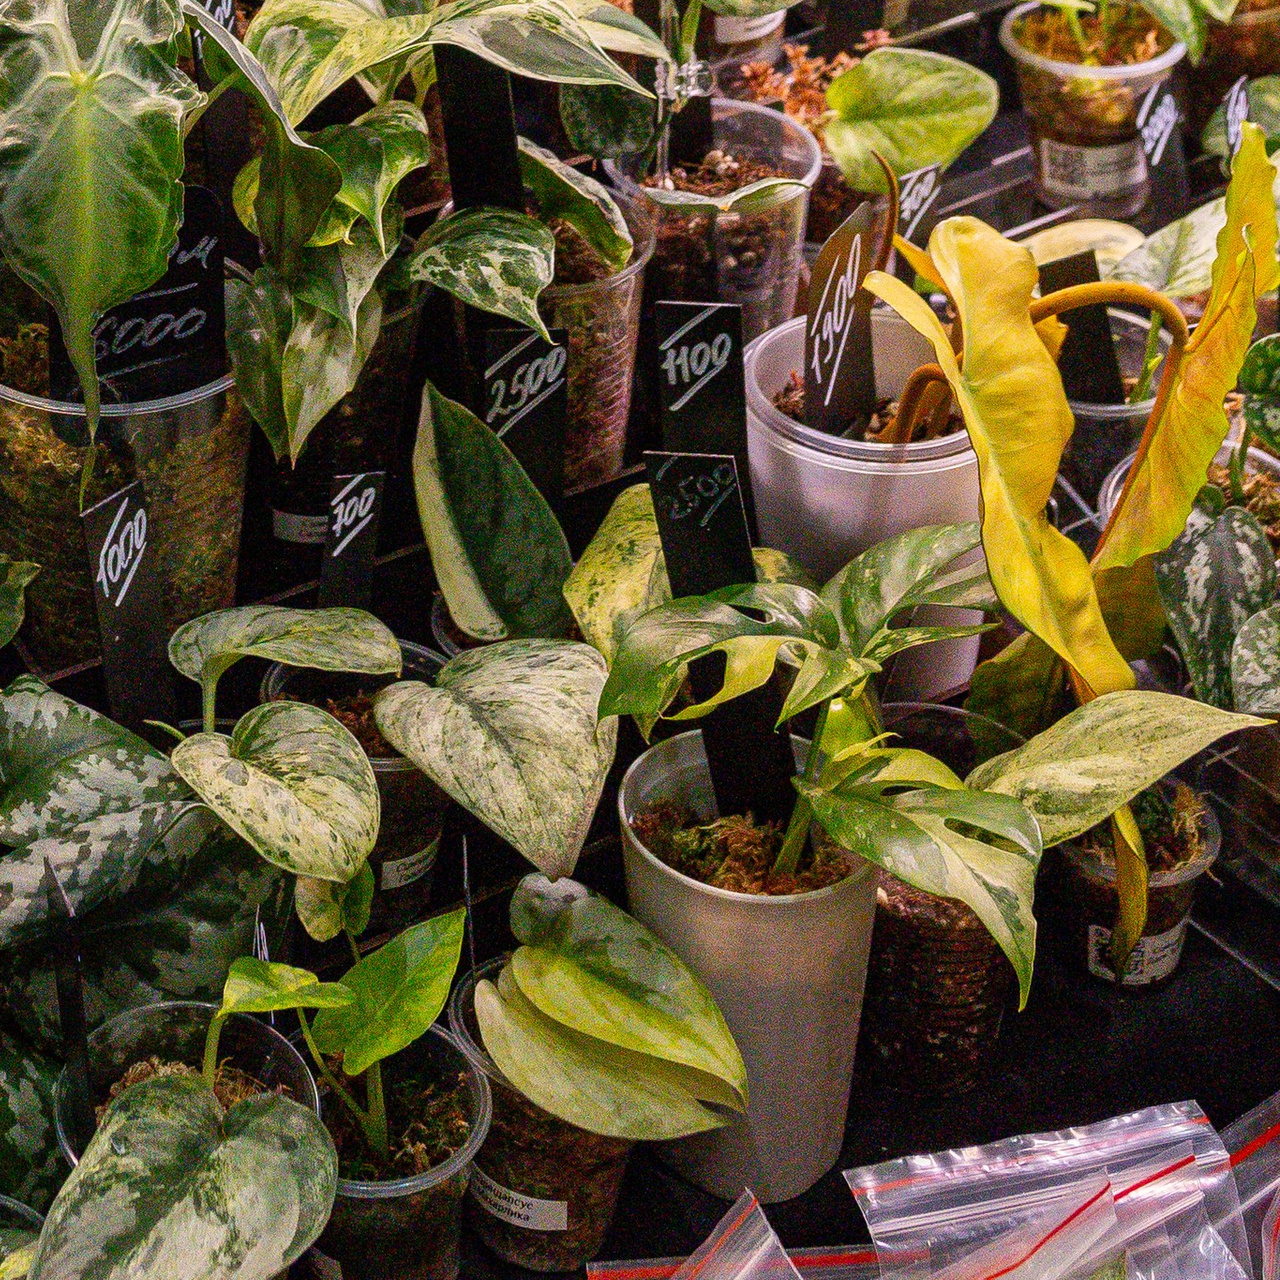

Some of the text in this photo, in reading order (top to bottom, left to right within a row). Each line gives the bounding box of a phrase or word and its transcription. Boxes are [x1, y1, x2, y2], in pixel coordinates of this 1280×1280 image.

[486, 345, 567, 424] 2500
[661, 332, 732, 386] 1100
[332, 487, 376, 539] 700
